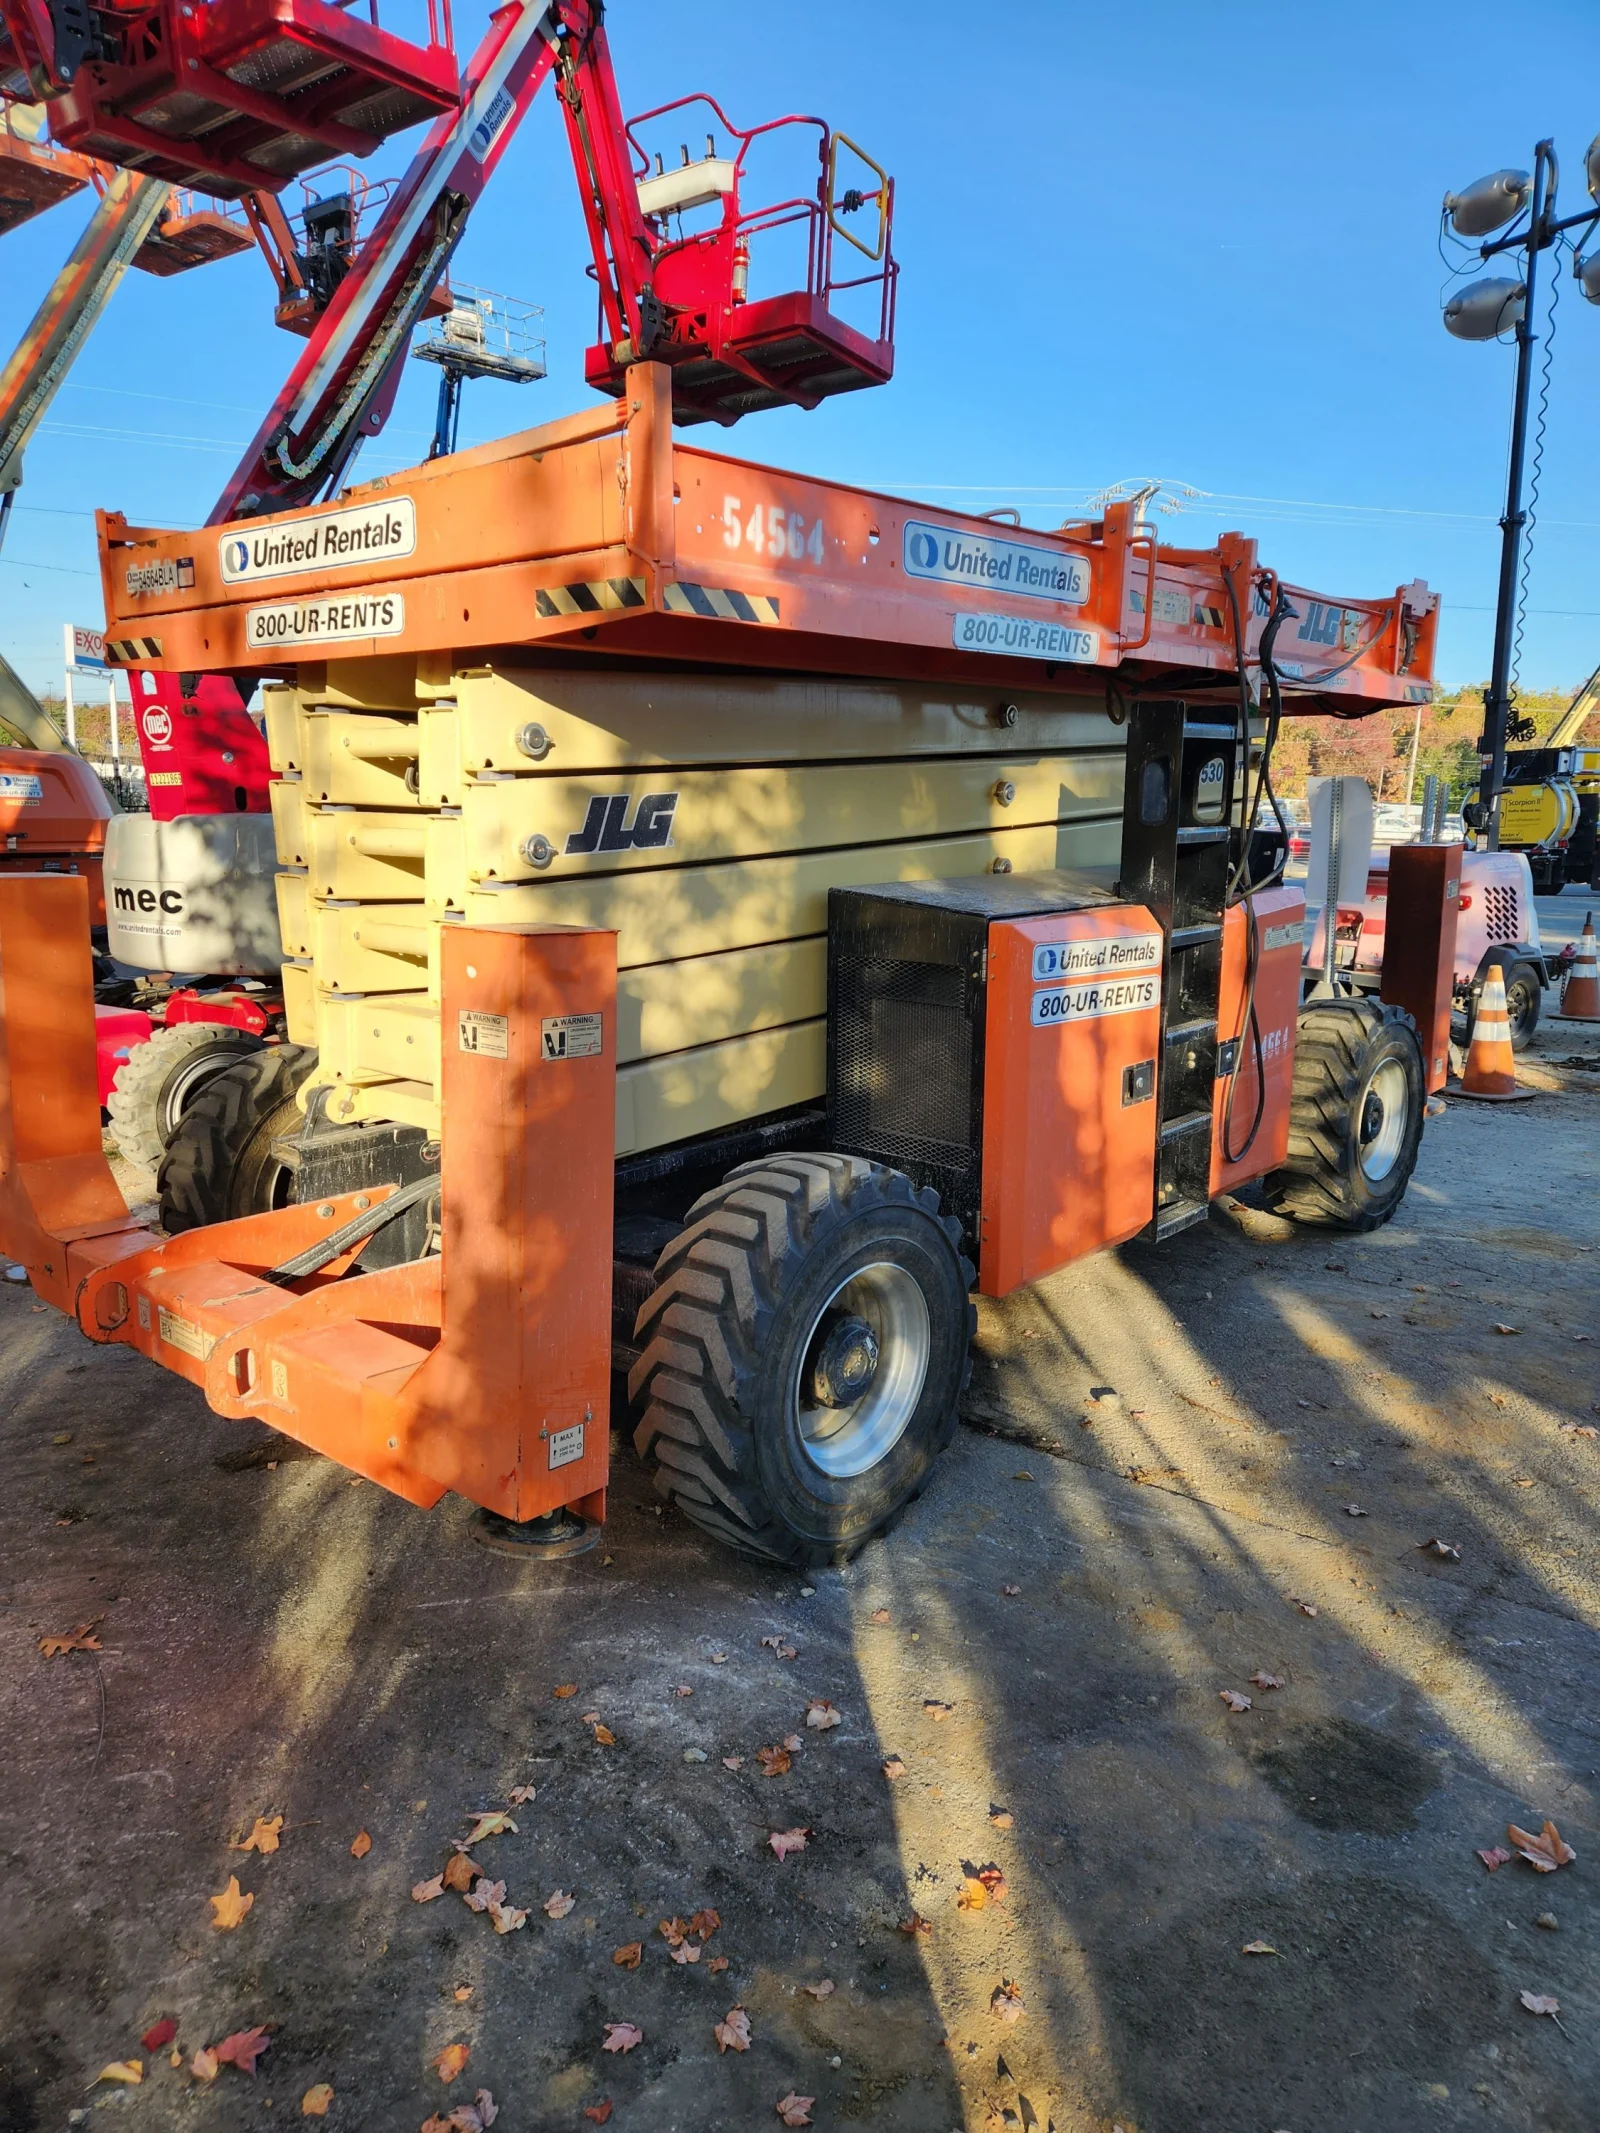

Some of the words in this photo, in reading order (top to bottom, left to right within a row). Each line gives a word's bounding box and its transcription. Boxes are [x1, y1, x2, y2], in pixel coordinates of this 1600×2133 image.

[483, 91, 503, 124] United
[489, 100, 511, 134] Rentals
[254, 528, 318, 568] United
[324, 513, 402, 556] Rentals
[723, 495, 824, 565] 54564
[943, 541, 1013, 581] United
[1015, 555, 1081, 593] Rentals
[255, 599, 394, 638] 800-UR-RENTS
[1298, 602, 1341, 646] JLG
[962, 618, 1092, 655] 800-UR-RENTS
[147, 714, 168, 734] mec
[1508, 798, 1536, 807] Scorpion
[563, 792, 680, 855] JLG
[114, 887, 183, 914] mec
[1060, 946, 1106, 970] United
[1108, 942, 1155, 964] Rentals
[1039, 982, 1153, 1018] 800-UR-RENTS
[472, 1013, 501, 1025] WARNING
[560, 1016, 594, 1026] WARNING
[560, 1432, 573, 1441] MAX
